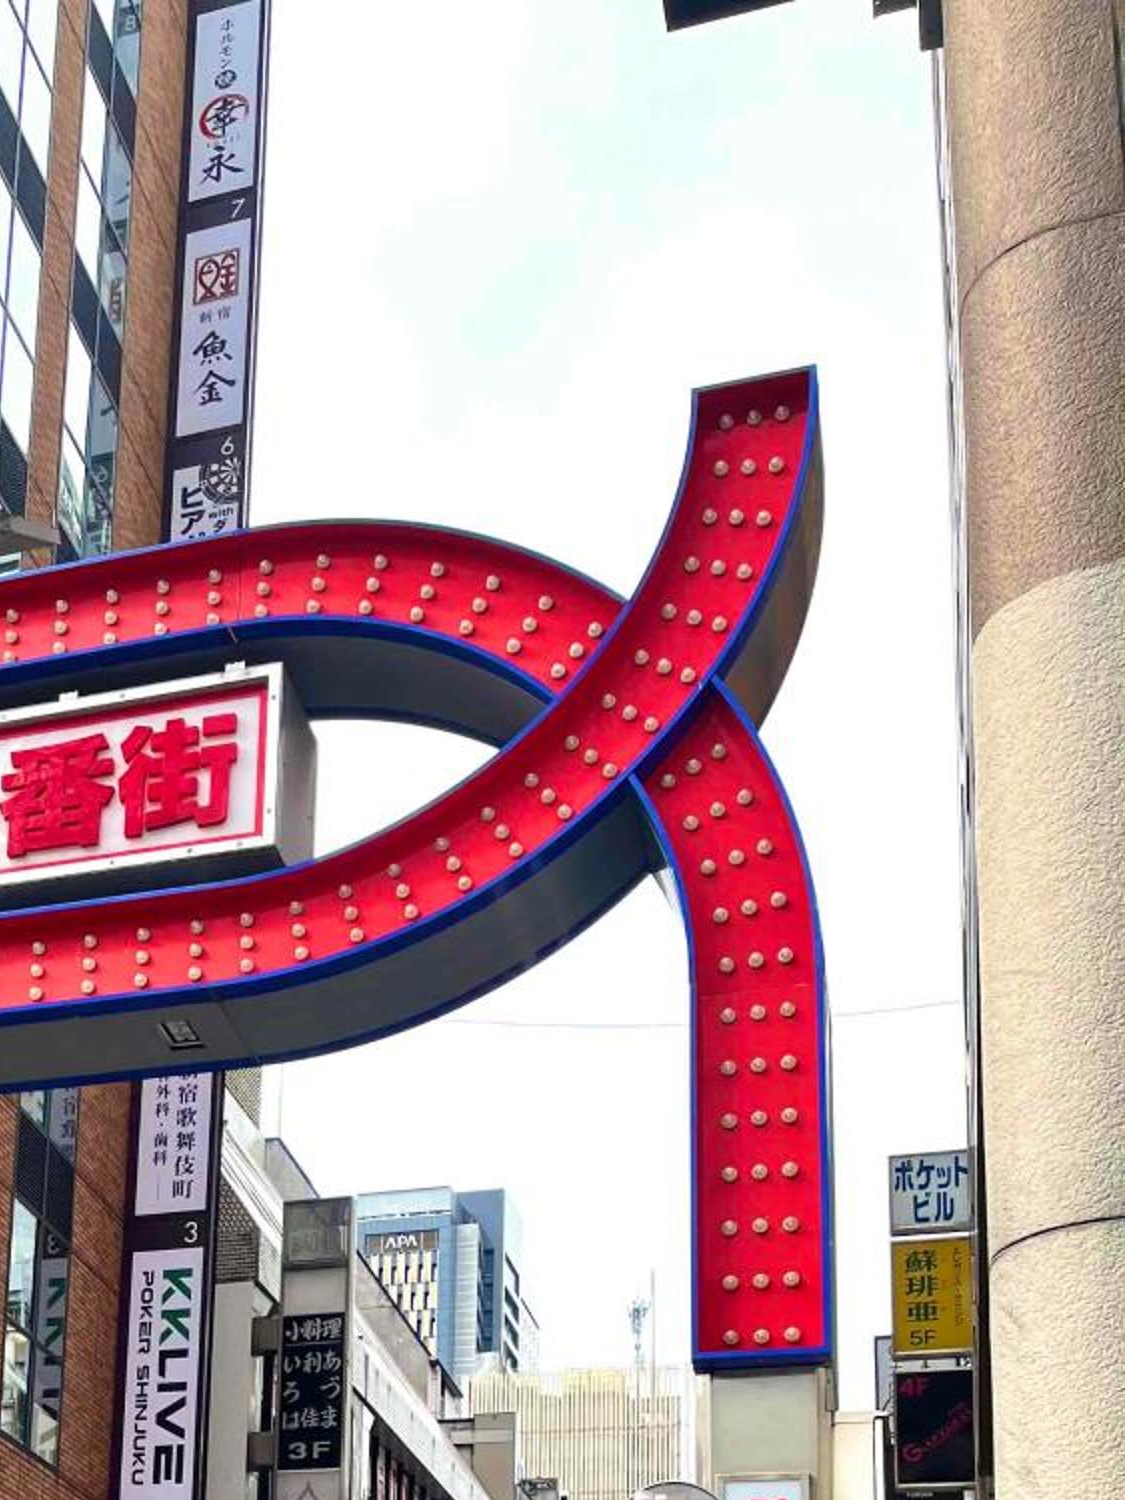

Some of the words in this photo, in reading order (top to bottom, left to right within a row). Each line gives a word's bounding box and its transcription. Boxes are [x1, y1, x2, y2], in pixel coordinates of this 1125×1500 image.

[231, 197, 246, 220] 7
[192, 329, 236, 406] 魚金
[220, 436, 235, 455] 6
[894, 1156, 969, 1192] ポケット
[913, 1191, 955, 1223] ビル
[183, 1221, 199, 1243] 3
[384, 1234, 418, 1250] APA
[138, 1270, 155, 1354] POKER
[285, 1318, 342, 1342] 小料理
[909, 1329, 938, 1345] 5F
[152, 1267, 194, 1485] KKLIVE
[281, 1354, 302, 1430] いろは
[320, 1350, 341, 1430] あづま
[131, 1365, 150, 1486] SHINJUKU
[287, 1440, 332, 1461] 3F
